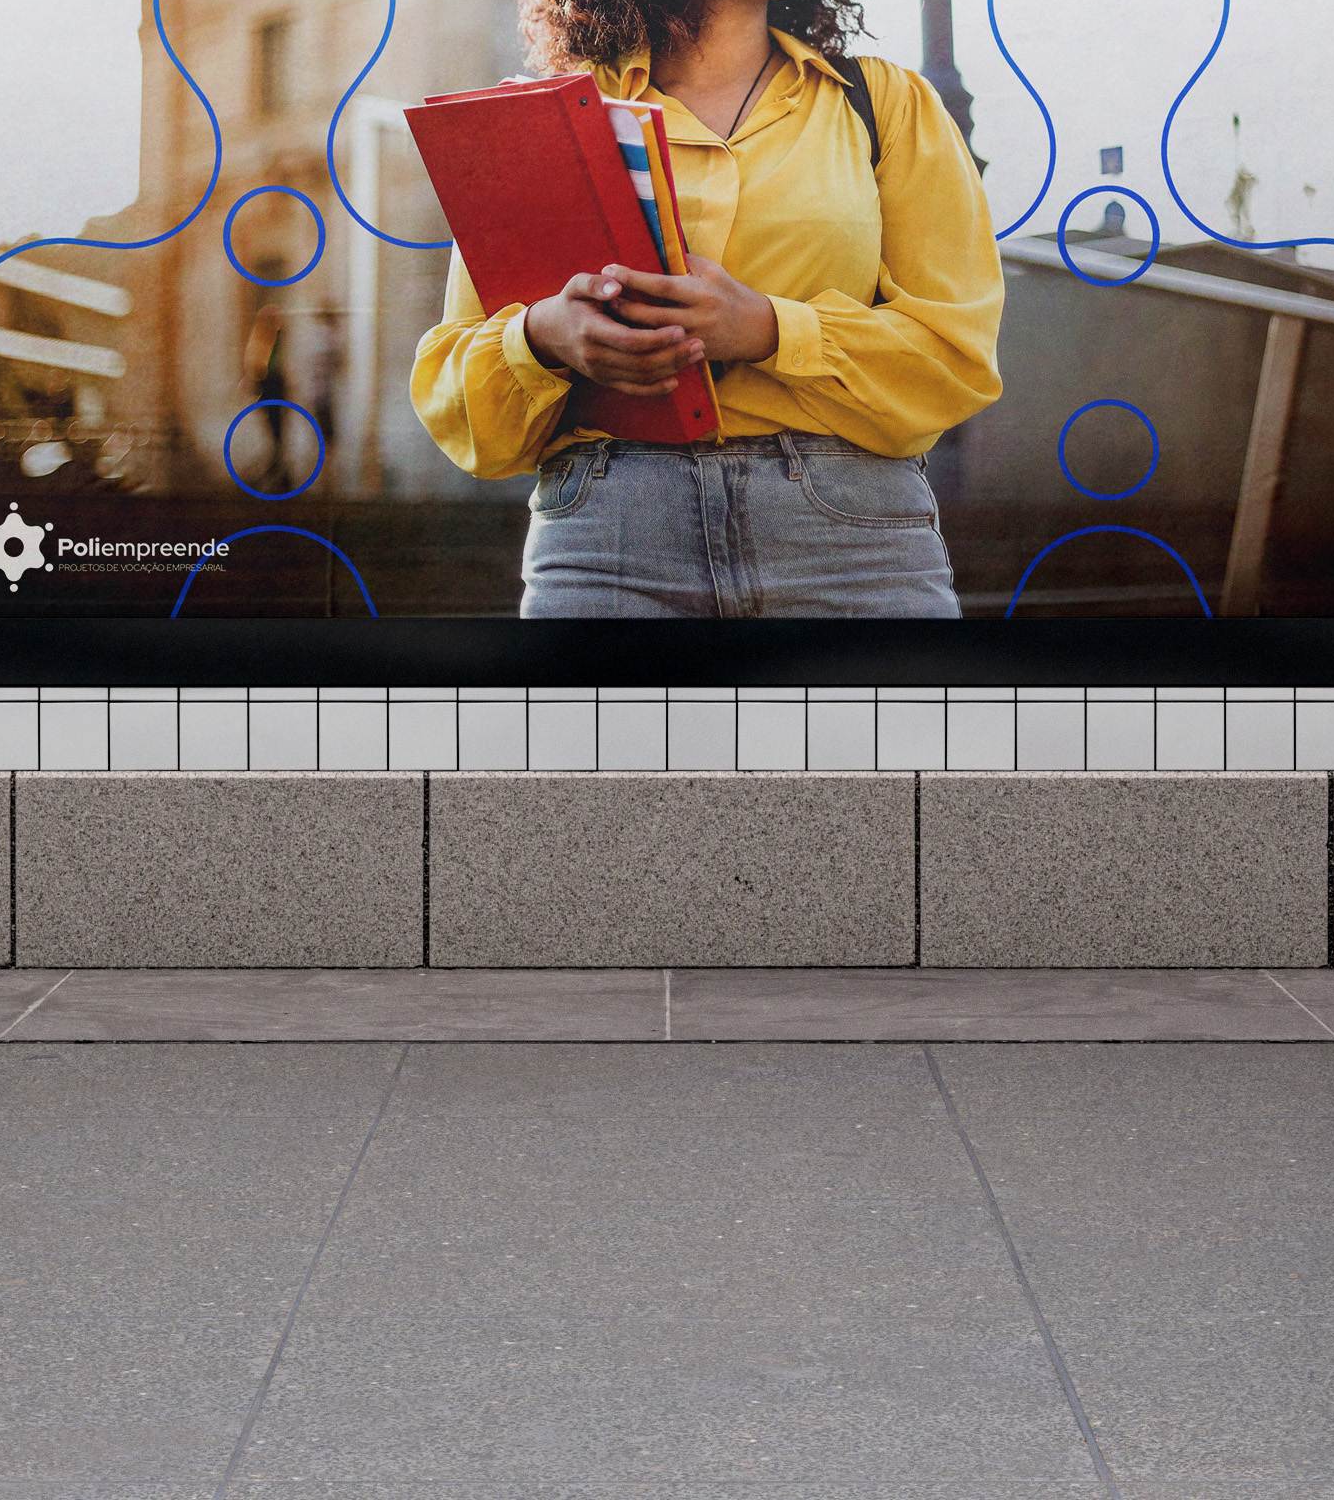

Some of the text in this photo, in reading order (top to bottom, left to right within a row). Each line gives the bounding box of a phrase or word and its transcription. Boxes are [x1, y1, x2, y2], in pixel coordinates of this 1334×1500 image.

[58, 536, 230, 562] Poliempreende
[58, 561, 227, 574] PROJETOS DE VOCAÇÃO EMPRESARIAL
